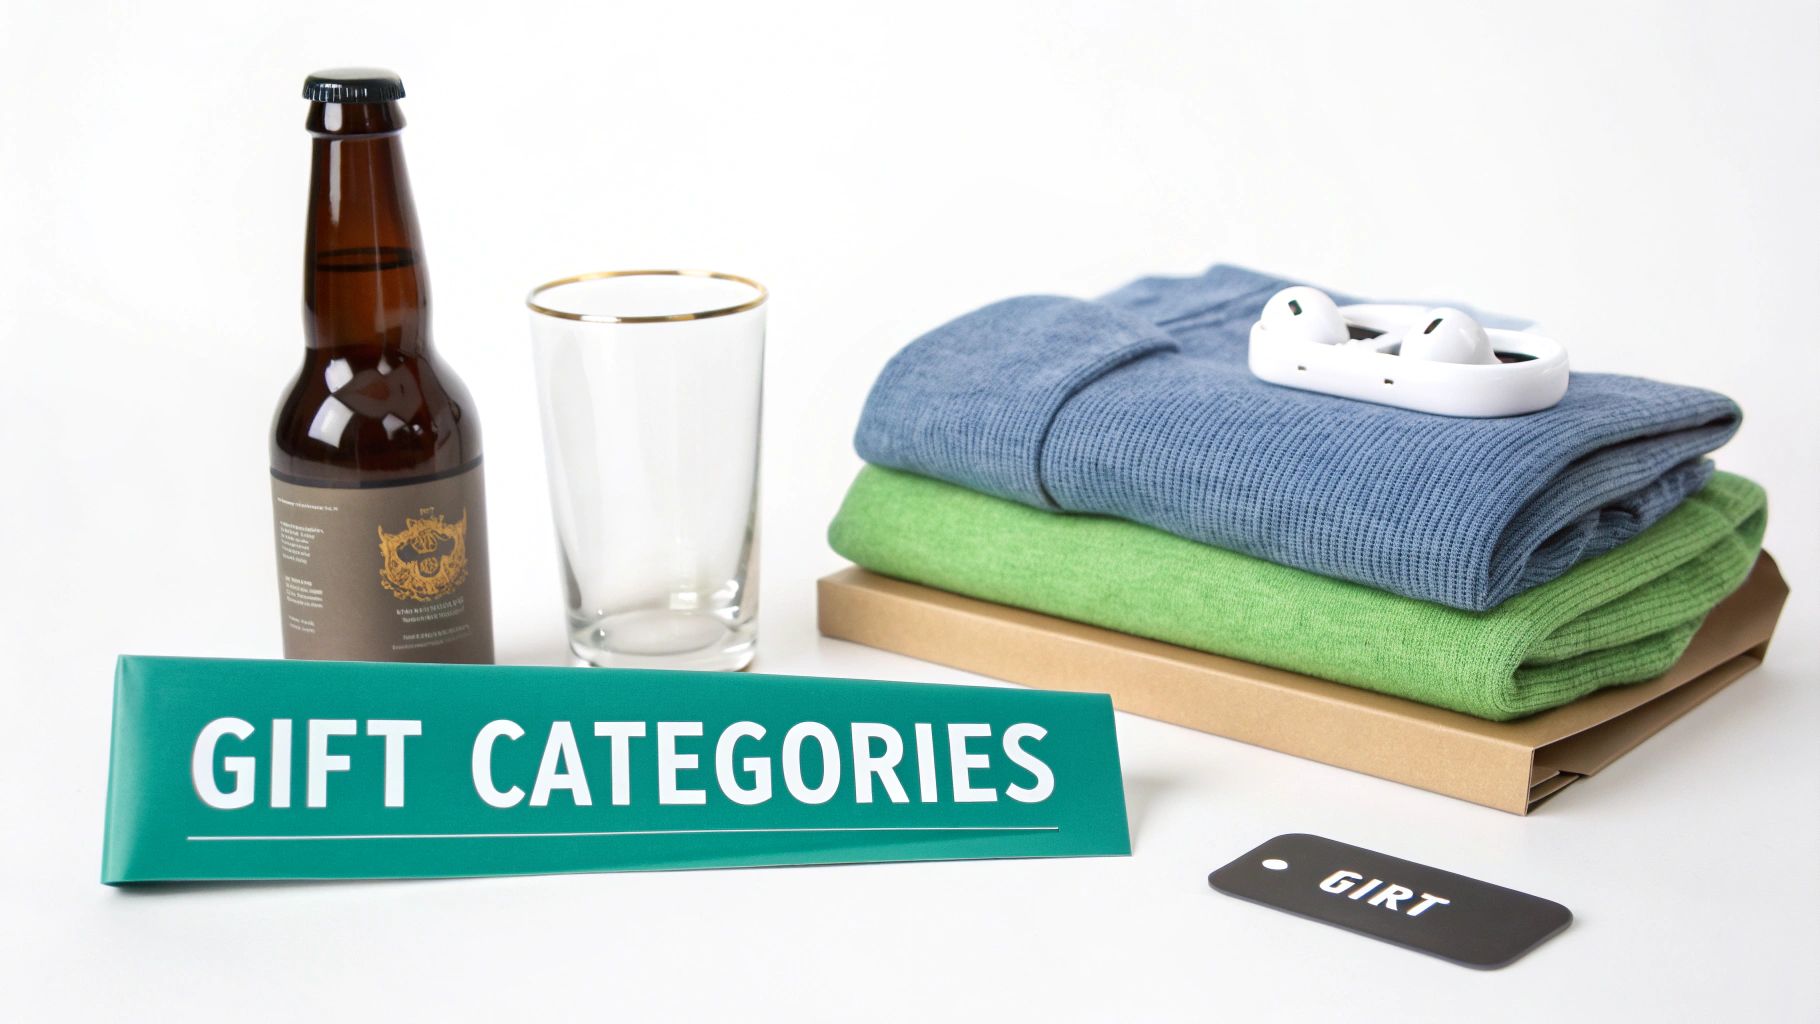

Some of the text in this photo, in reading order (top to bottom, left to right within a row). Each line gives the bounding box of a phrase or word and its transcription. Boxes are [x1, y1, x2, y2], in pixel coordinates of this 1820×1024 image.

[192, 718, 1054, 809] GIFT CATEGORIES
[1319, 870, 1450, 917] GIRT
